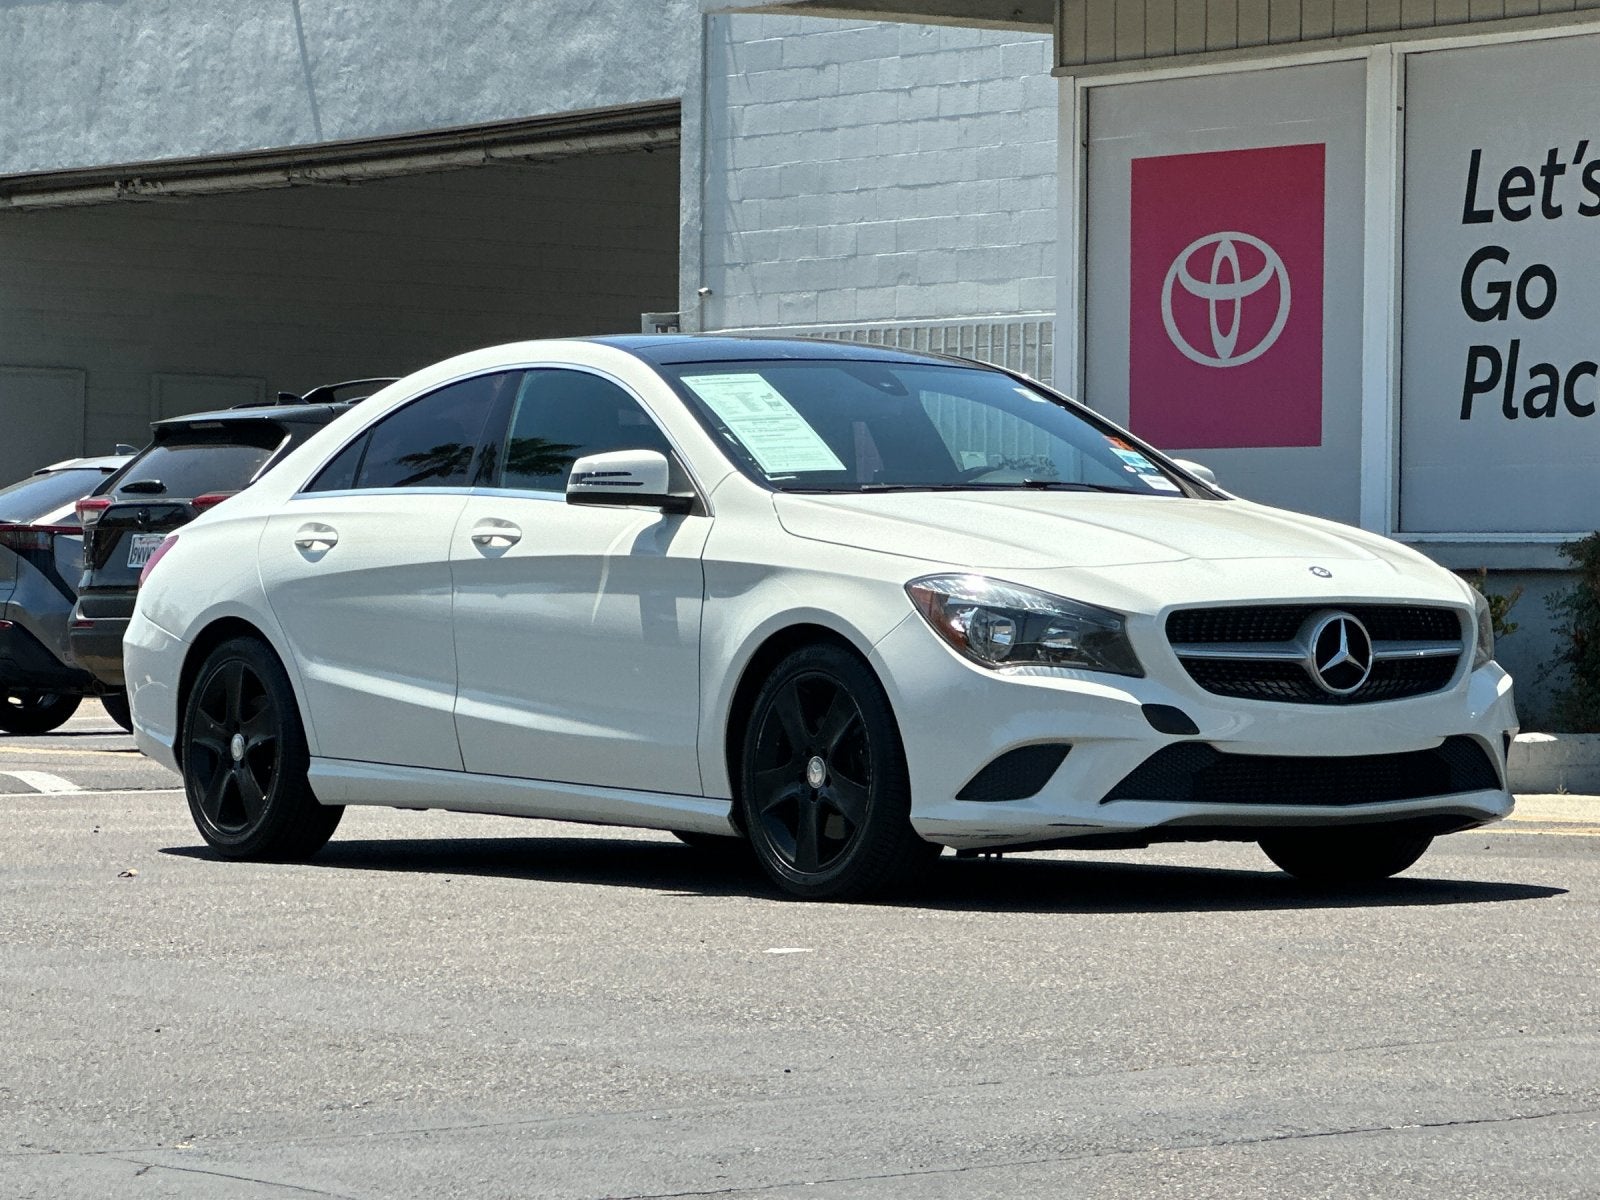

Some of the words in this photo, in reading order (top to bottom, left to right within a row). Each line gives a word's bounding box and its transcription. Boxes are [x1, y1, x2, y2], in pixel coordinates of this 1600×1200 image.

[1462, 139, 1600, 224] Let’s
[1461, 245, 1557, 322] Go
[1460, 338, 1599, 420] Plac
